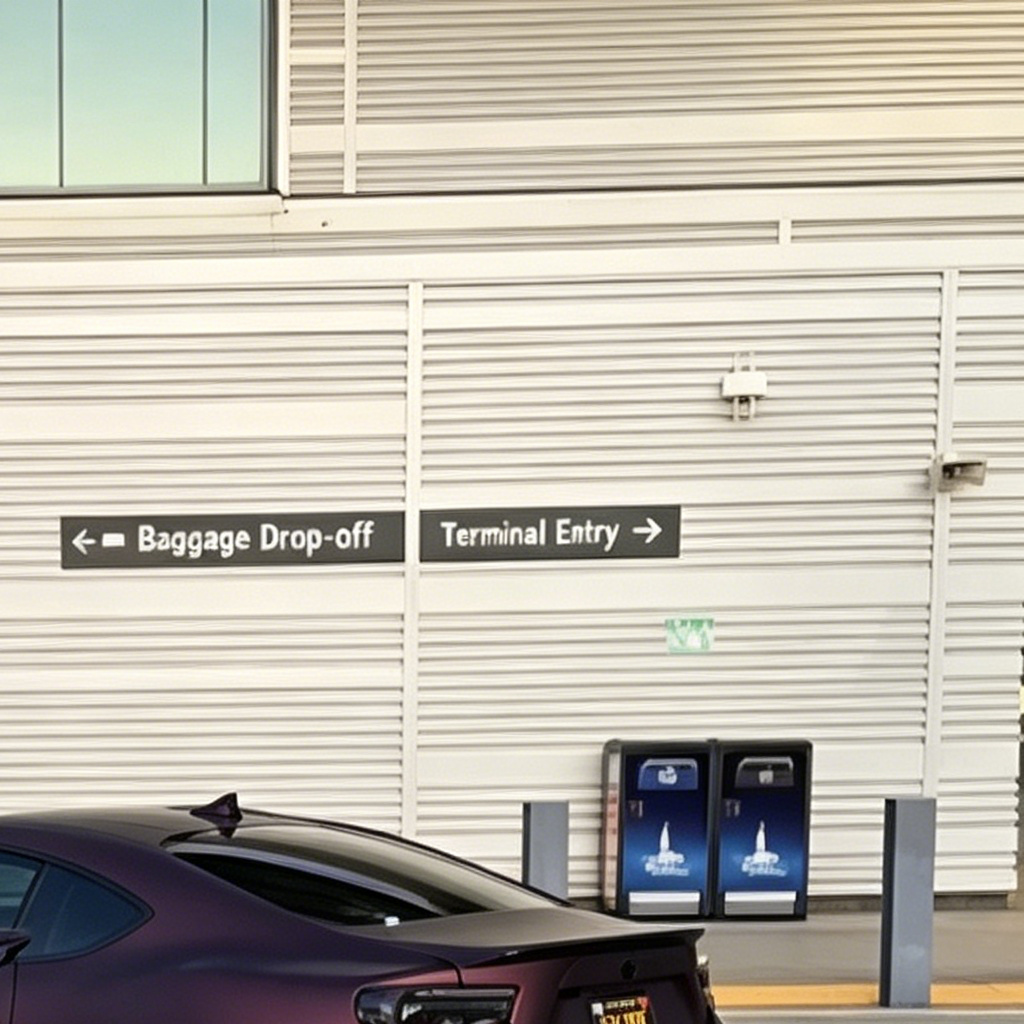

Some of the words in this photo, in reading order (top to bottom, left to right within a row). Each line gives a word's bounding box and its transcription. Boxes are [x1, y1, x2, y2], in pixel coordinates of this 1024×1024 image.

[137, 524, 251, 559] Baggage
[260, 520, 375, 558] Drop-off
[440, 518, 546, 548] Terminal
[556, 517, 620, 552] Entry
